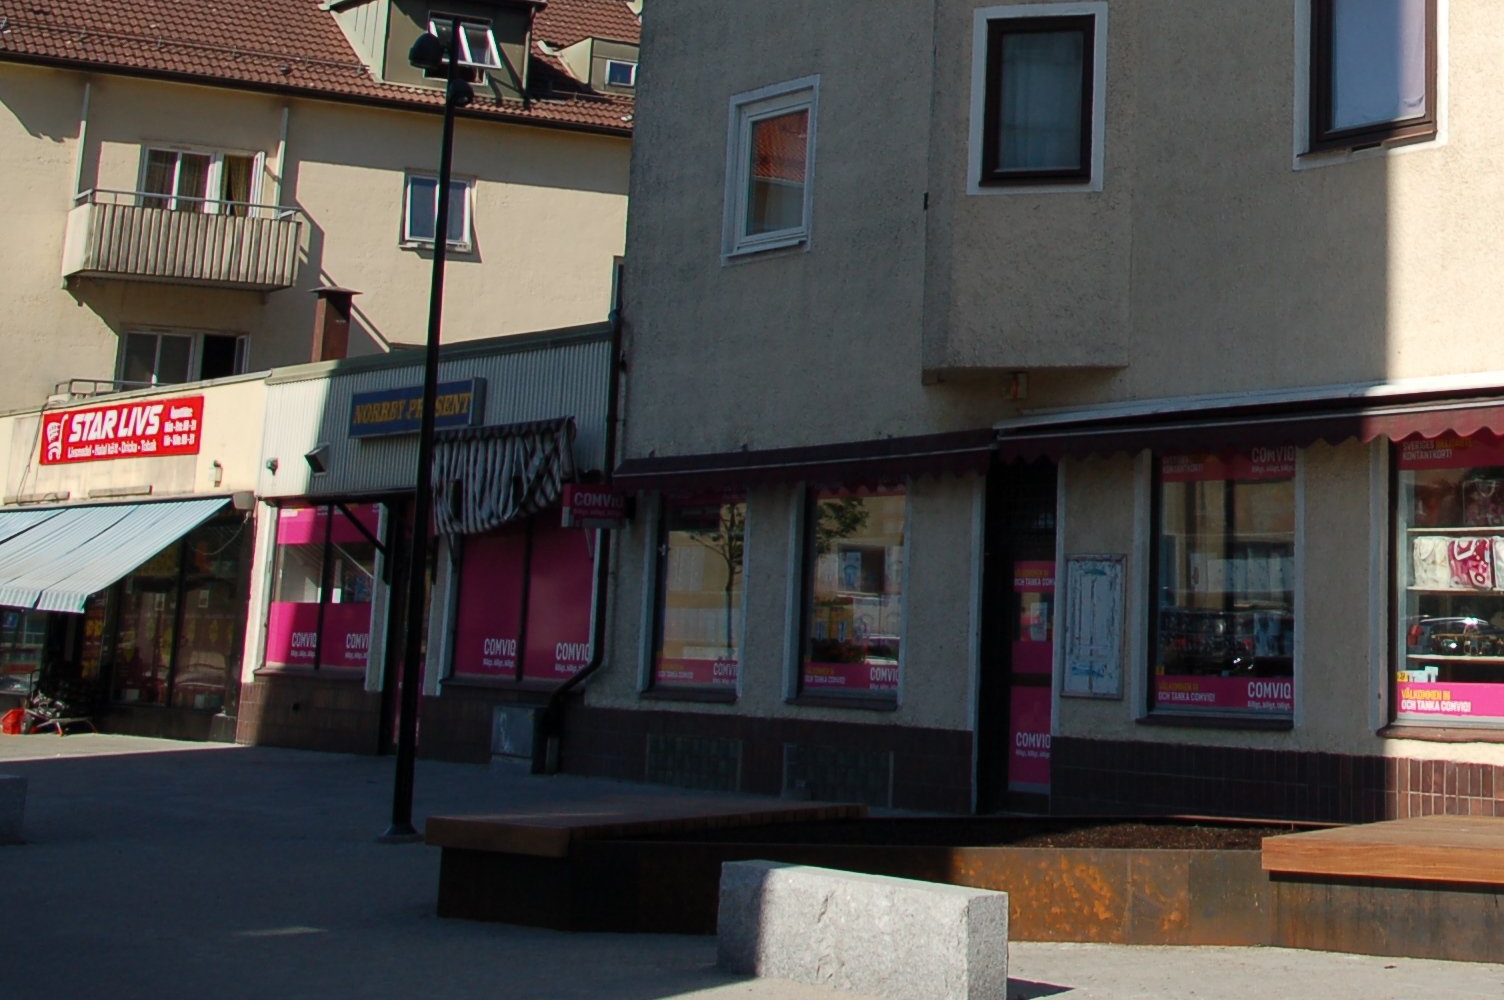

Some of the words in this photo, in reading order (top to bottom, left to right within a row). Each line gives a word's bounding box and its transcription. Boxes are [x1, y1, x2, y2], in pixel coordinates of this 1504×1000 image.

[408, 391, 472, 420] PRSENT
[68, 409, 118, 443] STAR
[117, 404, 164, 438] LIVS
[484, 638, 517, 656] COMVIQ
[1247, 681, 1293, 700] COMVIQ
